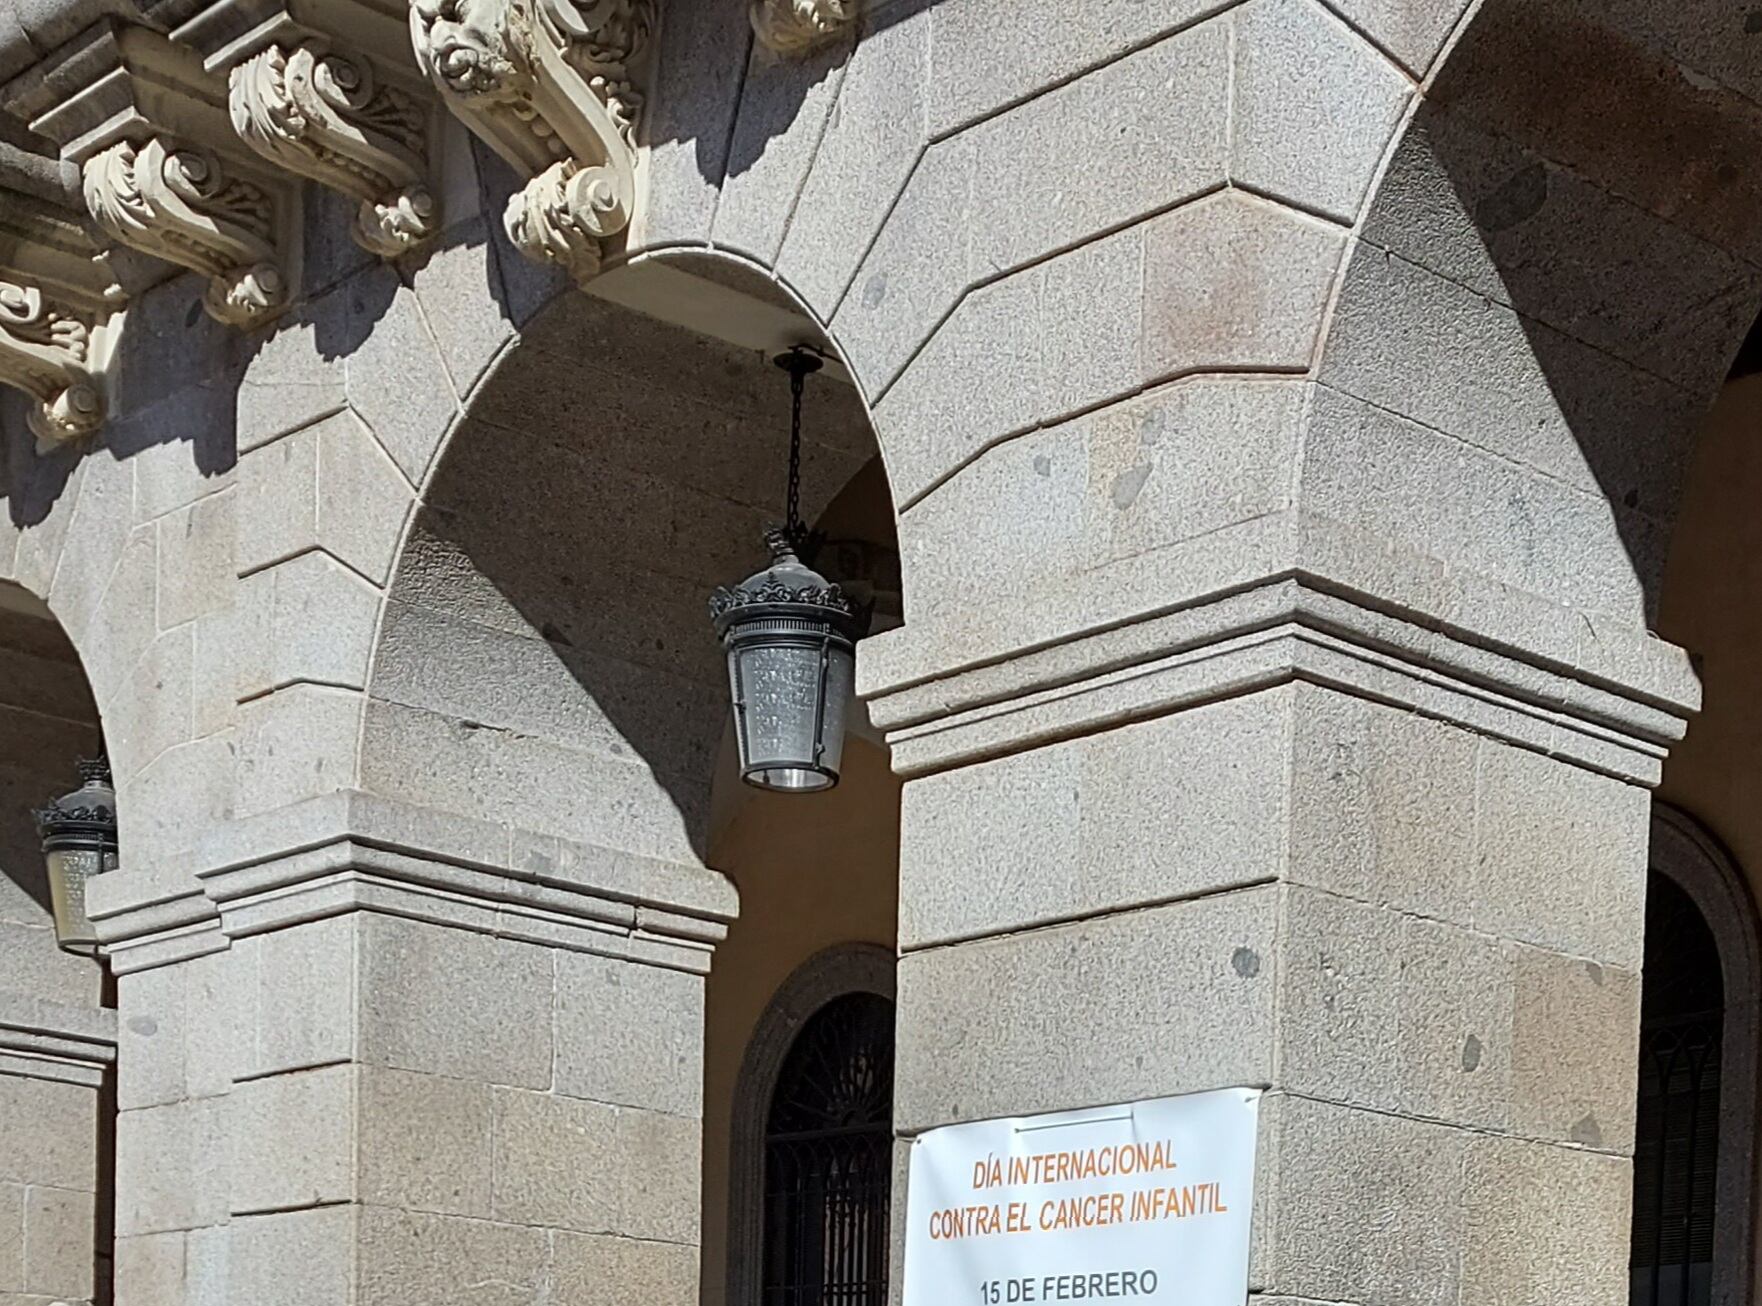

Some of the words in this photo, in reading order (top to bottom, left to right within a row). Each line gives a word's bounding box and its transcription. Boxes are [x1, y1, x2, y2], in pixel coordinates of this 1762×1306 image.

[972, 1151, 1002, 1189] DÍA
[1008, 1139, 1177, 1186] INTERNACIONAL
[929, 1204, 1001, 1240] CONTRA
[1006, 1202, 1032, 1233] EL
[1039, 1193, 1125, 1231] CANCER
[1130, 1182, 1228, 1222] INFANTIL
[980, 1280, 1000, 1306] 15
[1006, 1277, 1036, 1303] DE
[1042, 1269, 1158, 1301] FEBRERO
